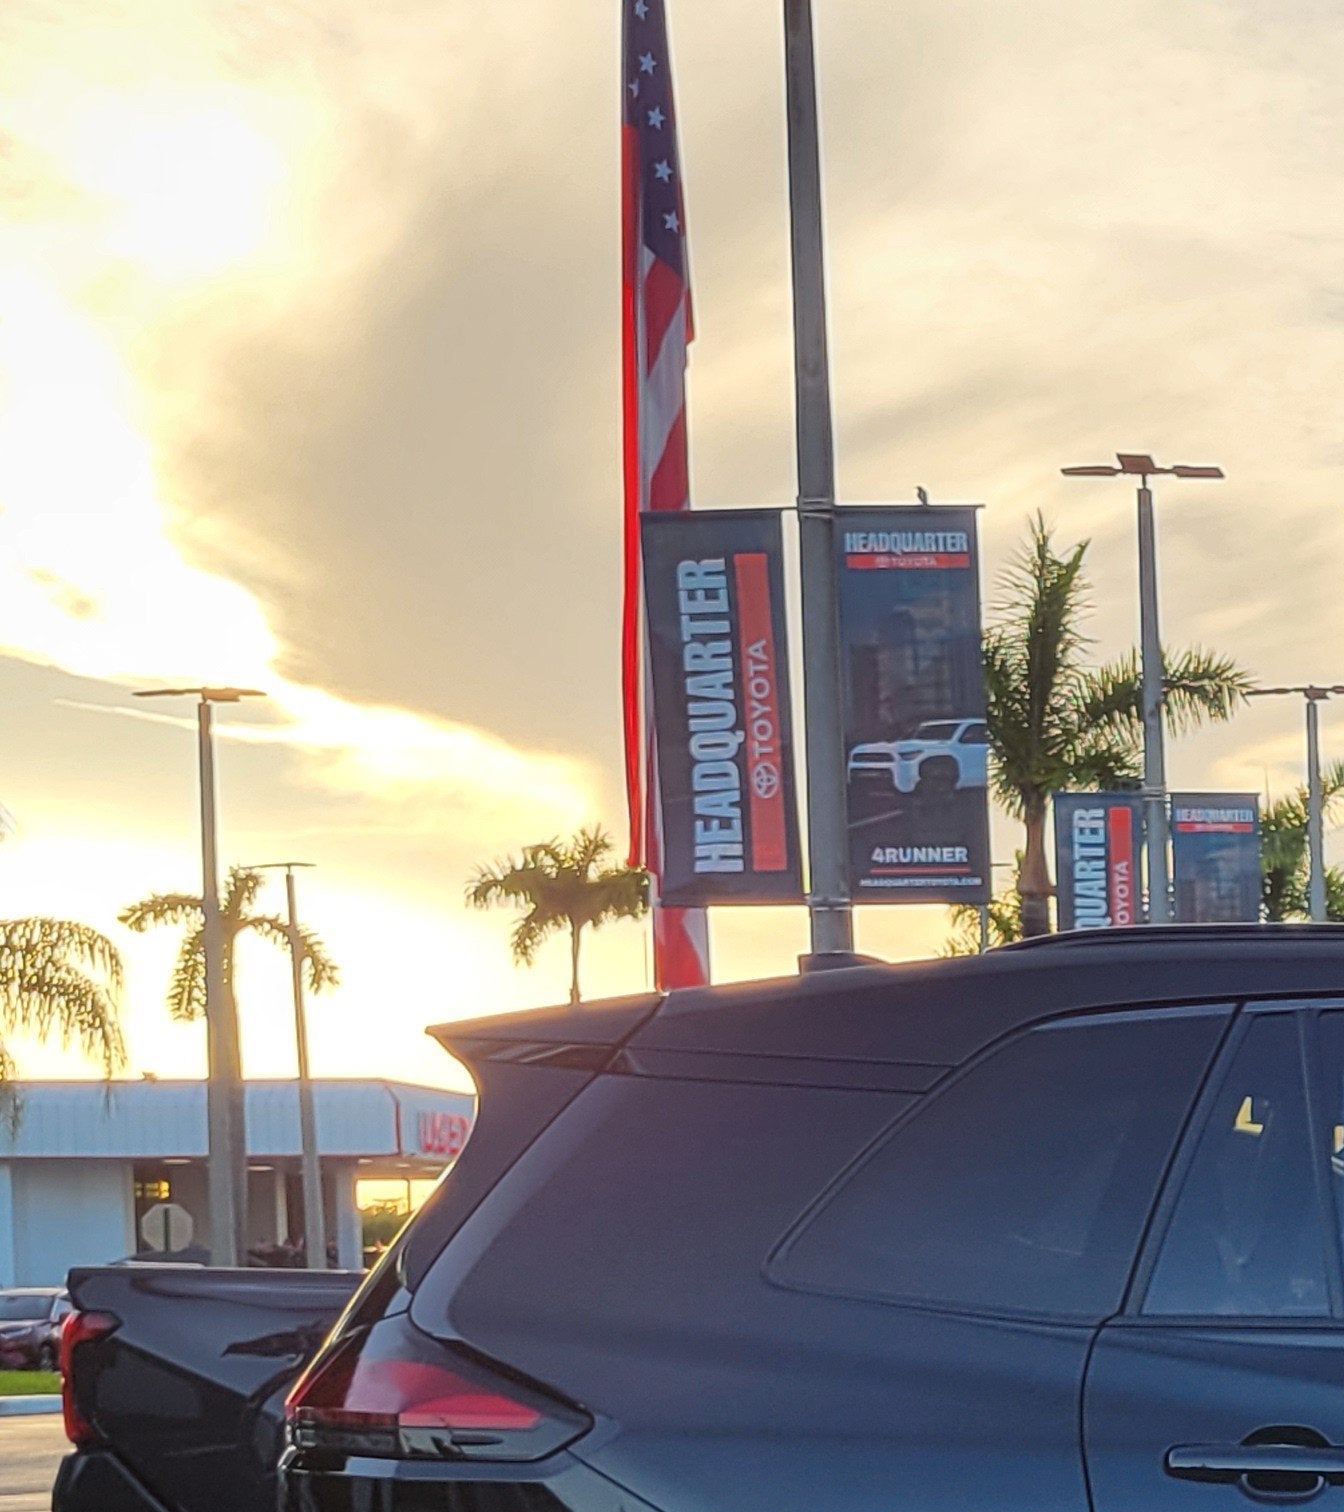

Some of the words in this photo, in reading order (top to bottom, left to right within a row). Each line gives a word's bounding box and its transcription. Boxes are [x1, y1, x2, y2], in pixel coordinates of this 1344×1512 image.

[845, 532, 968, 554] HEADQUARTER
[677, 558, 744, 873] HEADQUARTER
[751, 640, 773, 758] TOYOTA
[871, 847, 968, 863] 4RUNNER
[1074, 809, 1111, 928] QUARTER
[1115, 861, 1130, 925] OYOTA
